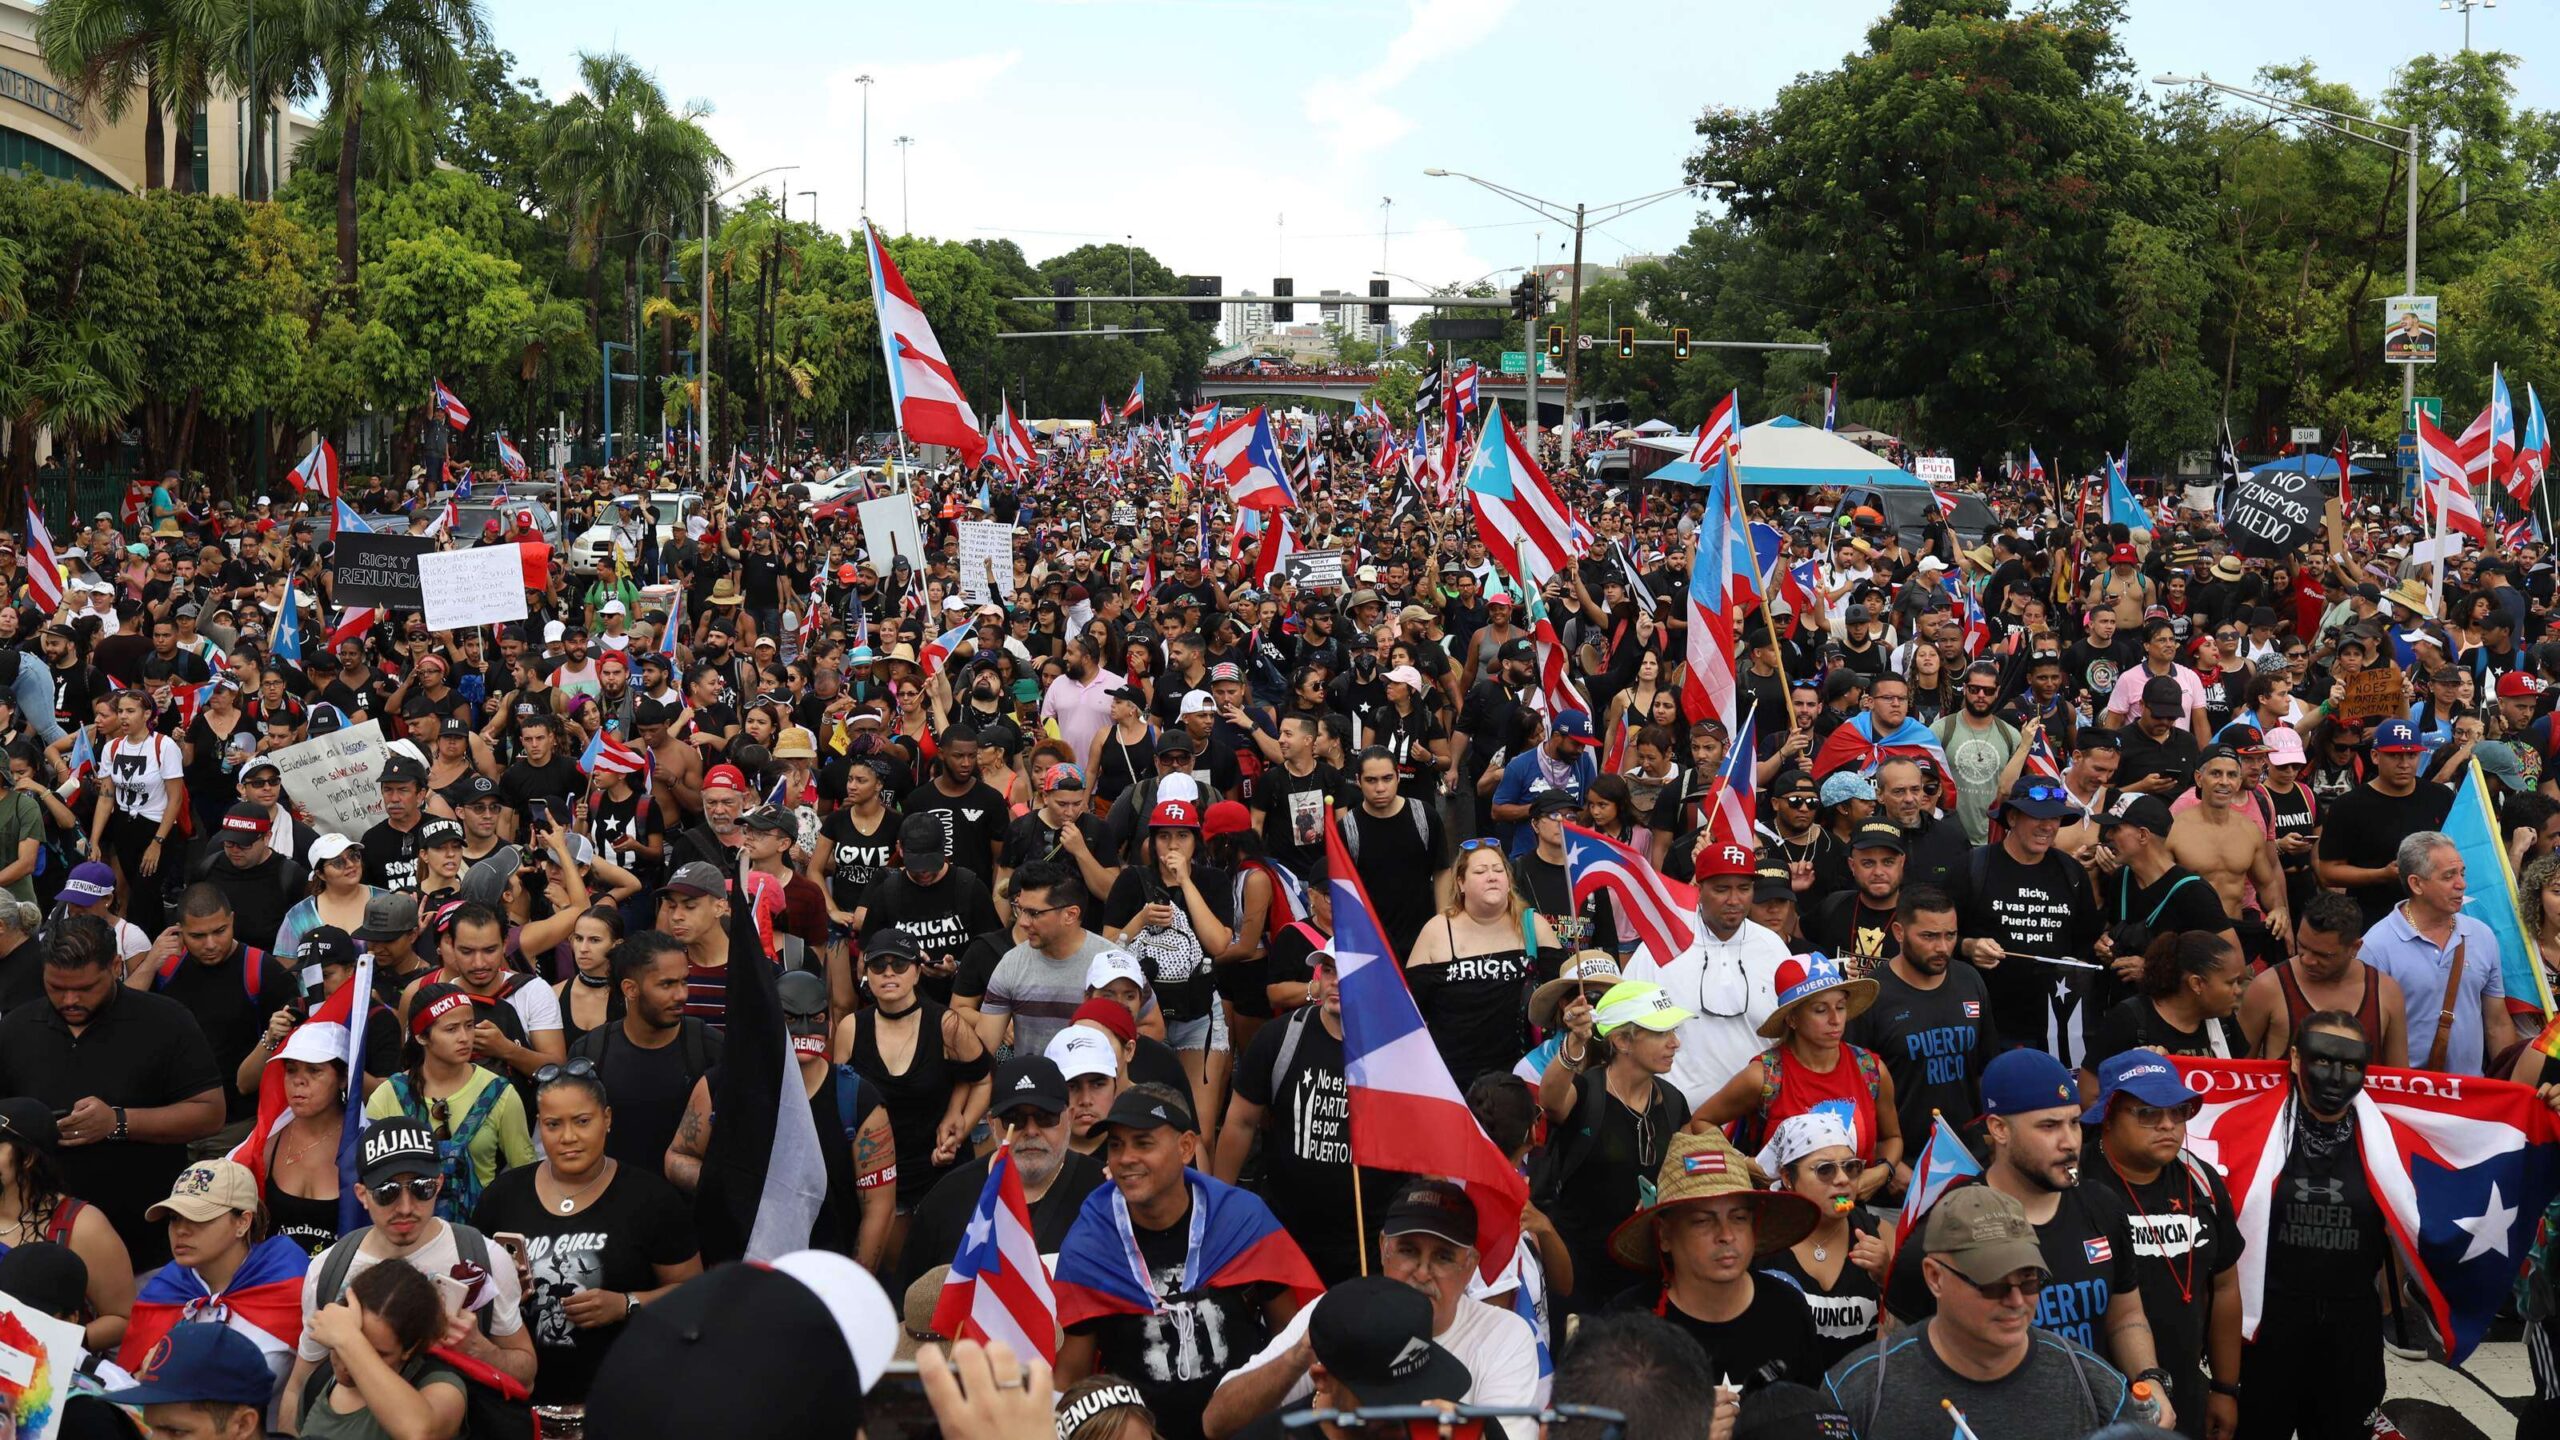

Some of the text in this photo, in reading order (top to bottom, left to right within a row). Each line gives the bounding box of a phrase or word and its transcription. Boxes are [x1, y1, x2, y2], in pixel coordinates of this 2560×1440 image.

[2298, 431, 2314, 440] SUR
[1922, 464, 1952, 473] PUTA
[2270, 471, 2307, 494] NO
[2237, 481, 2310, 524] TENEMOS
[2228, 498, 2292, 544] MIEDO
[358, 552, 411, 570] RICKY
[71, 880, 103, 894] RENUNCIA
[2018, 887, 2050, 901] Ricky,
[2006, 903, 2026, 912] vas
[2028, 904, 2046, 915] por
[2001, 914, 2062, 928] Puerto Rico
[2010, 932, 2053, 943] va por ti
[1796, 977, 1838, 995] PUERTO
[430, 995, 455, 1017] RICKY
[1905, 1025, 1976, 1060] PUERTO
[1317, 1068, 1343, 1091] No es
[1927, 1054, 1964, 1085] RICO
[1312, 1119, 1340, 1139] es por
[365, 1128, 434, 1162] BÁJALE
[1308, 1139, 1349, 1163] PUERTO
[2286, 1203, 2352, 1228] UNDER
[553, 1231, 609, 1259] GIRLS
[2278, 1223, 2360, 1250] ARMOUR
[1393, 1365, 1412, 1377] NIKE
